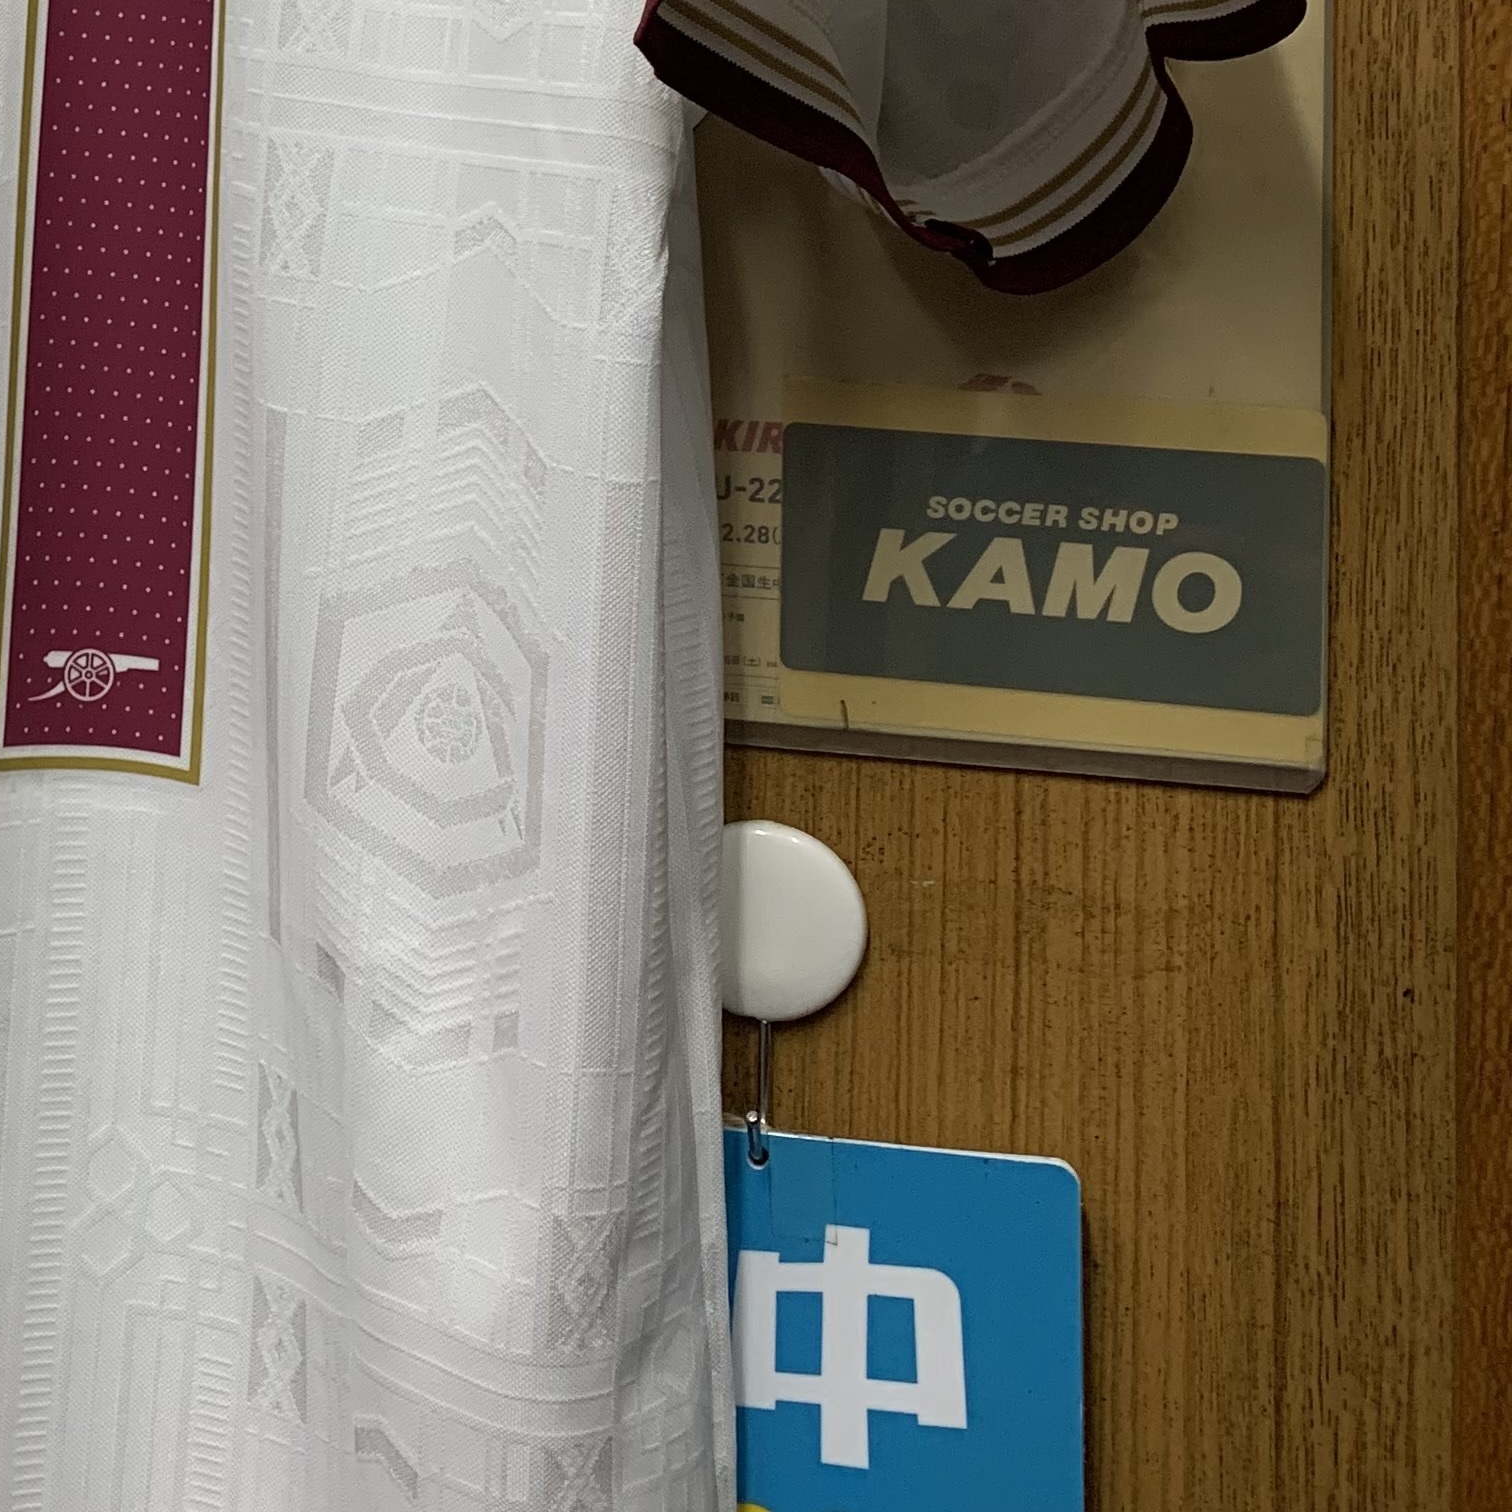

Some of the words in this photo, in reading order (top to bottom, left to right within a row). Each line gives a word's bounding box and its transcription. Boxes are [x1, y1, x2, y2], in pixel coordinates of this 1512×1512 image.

[926, 495, 1068, 529] SOCCER
[1078, 506, 1179, 536] SHOP
[861, 528, 1243, 635] KAMO
[732, 1224, 968, 1469] 中
